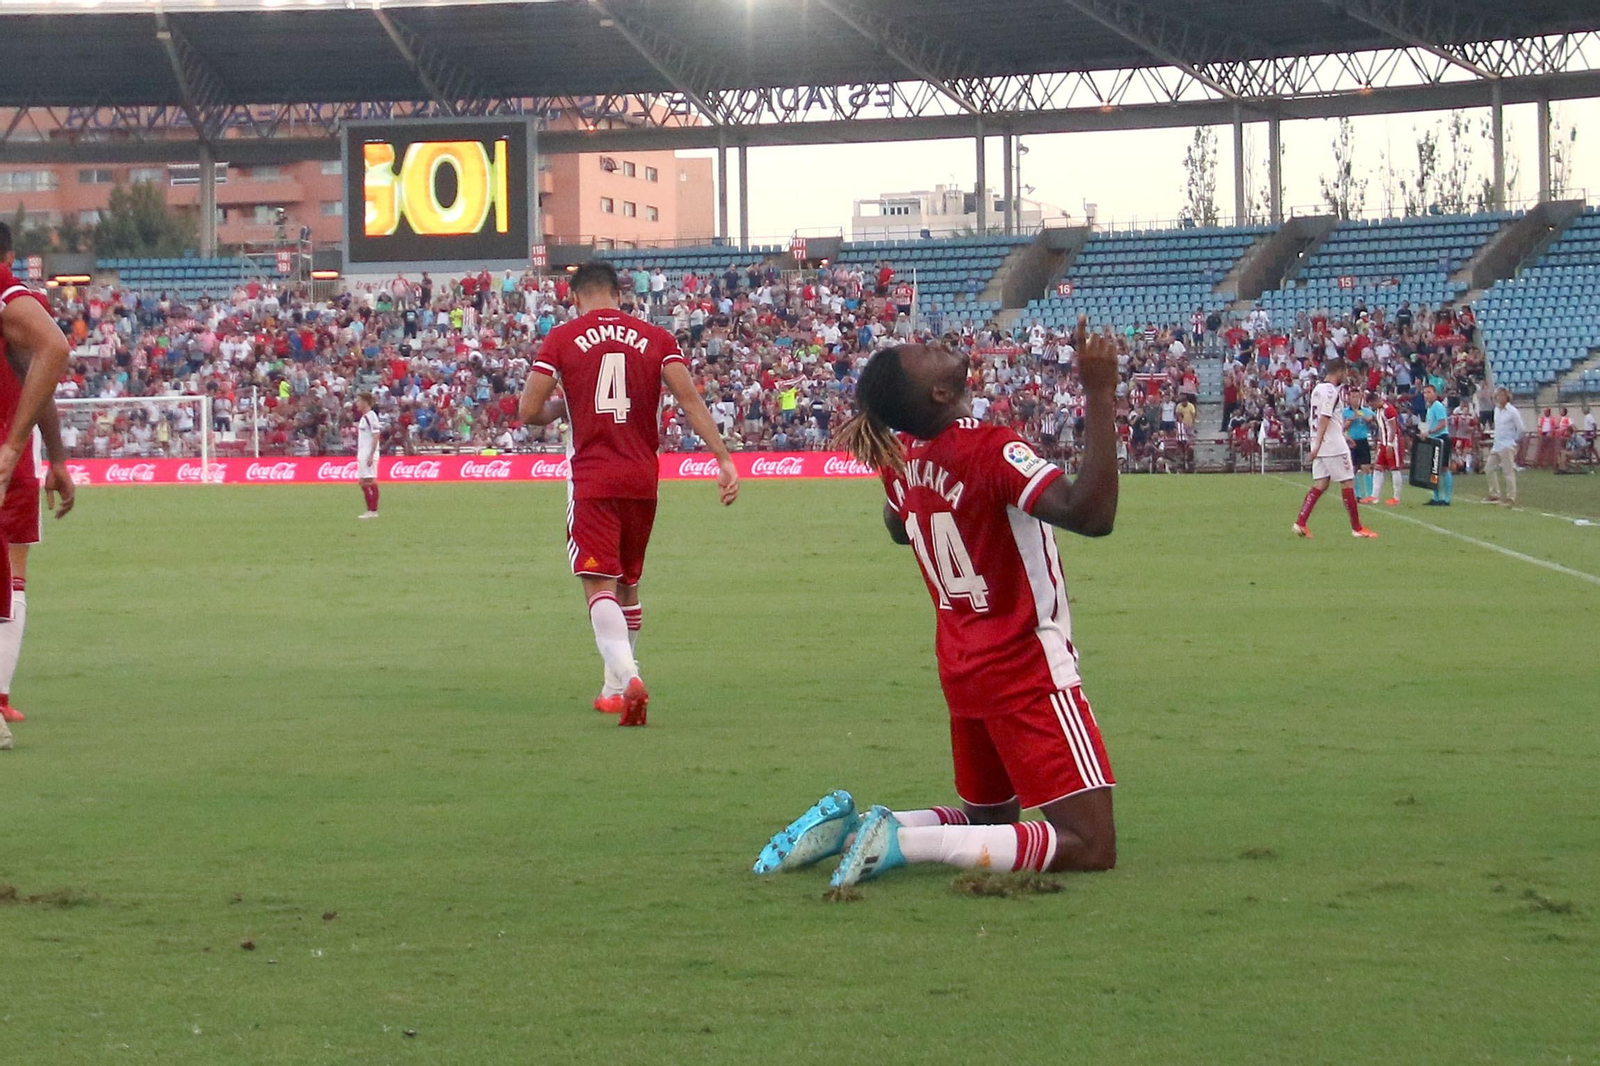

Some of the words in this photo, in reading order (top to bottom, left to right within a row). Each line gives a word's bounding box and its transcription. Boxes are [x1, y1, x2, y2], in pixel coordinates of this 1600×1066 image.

[1058, 284, 1070, 295] 16
[1339, 278, 1352, 288] 15
[574, 325, 649, 354] ROMERA
[594, 352, 631, 423] 4
[905, 511, 989, 613] 14
